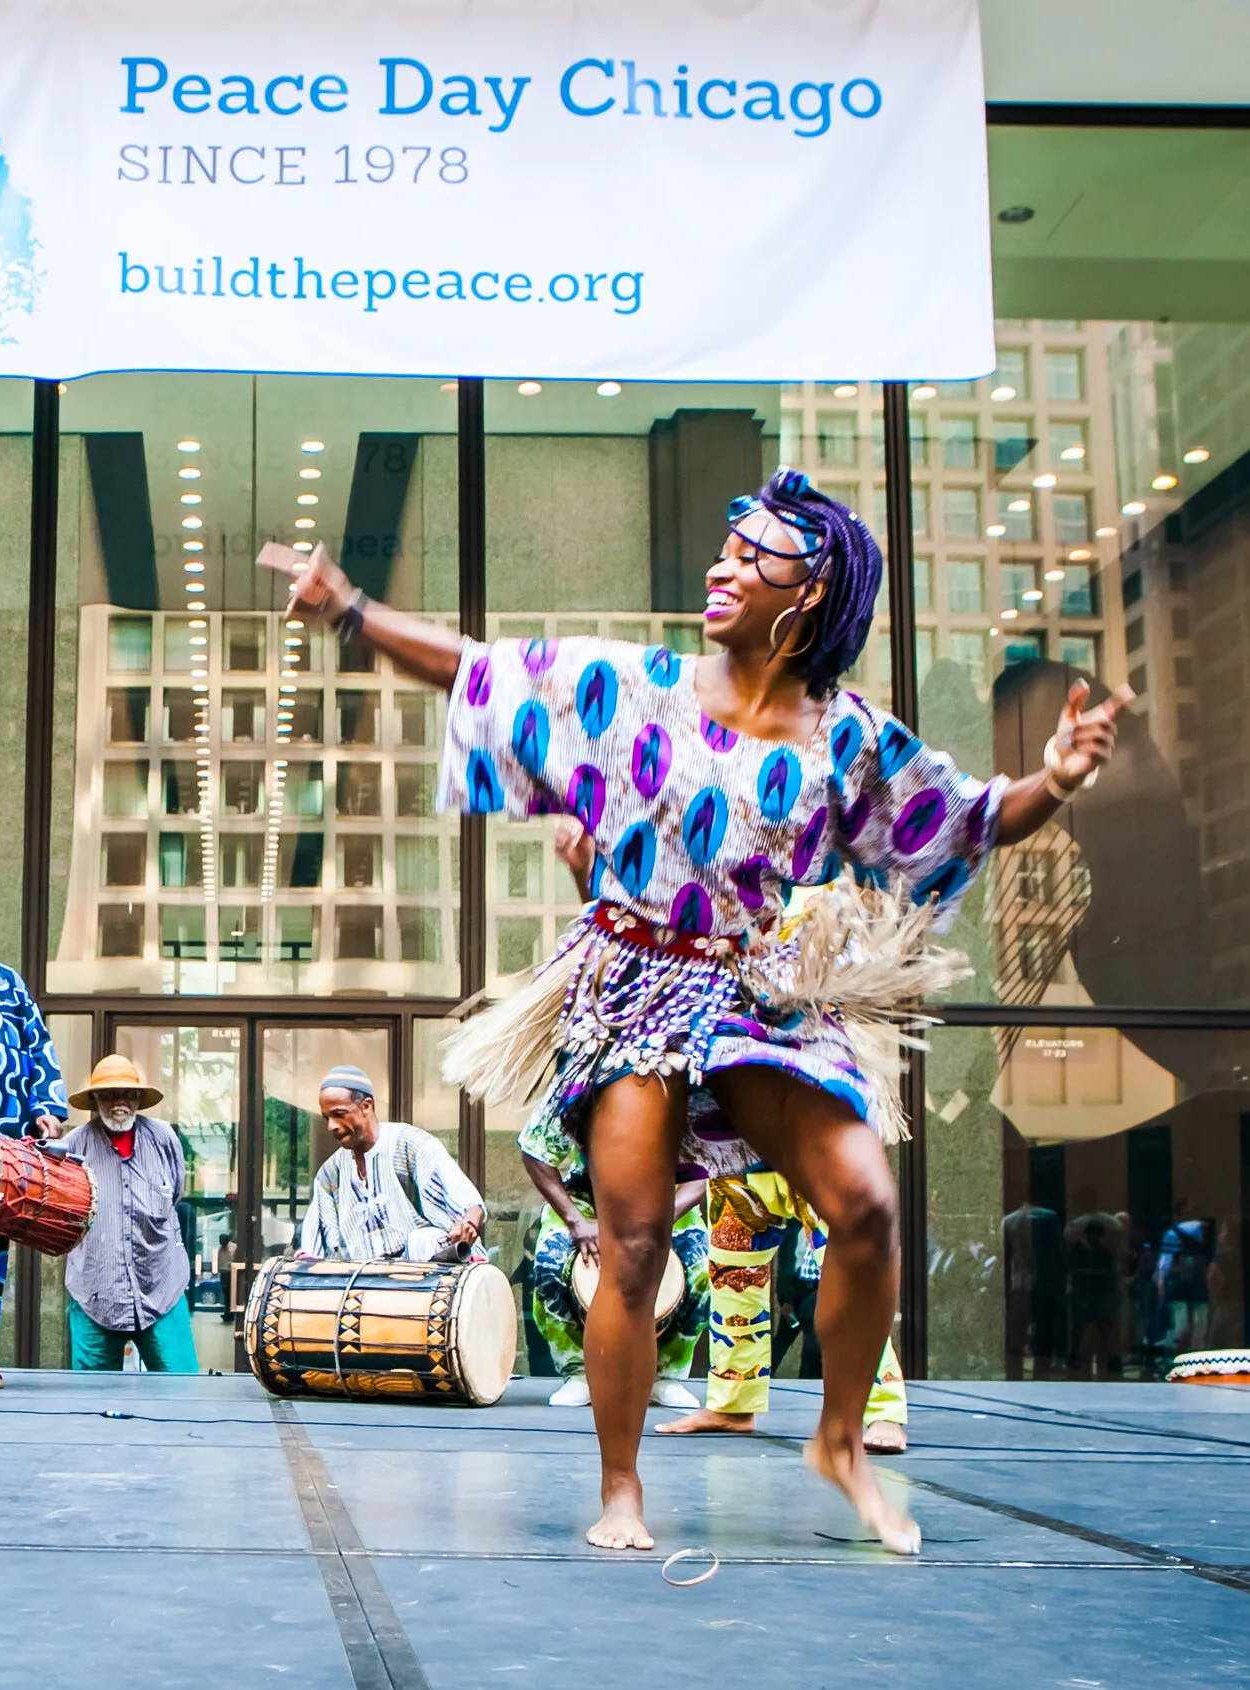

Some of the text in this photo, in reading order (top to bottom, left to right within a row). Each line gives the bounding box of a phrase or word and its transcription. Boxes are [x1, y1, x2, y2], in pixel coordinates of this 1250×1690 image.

[118, 55, 884, 139] Peace Day Chicago
[117, 143, 470, 185] SINCE 1978
[117, 251, 645, 315] buildthepeace.org
